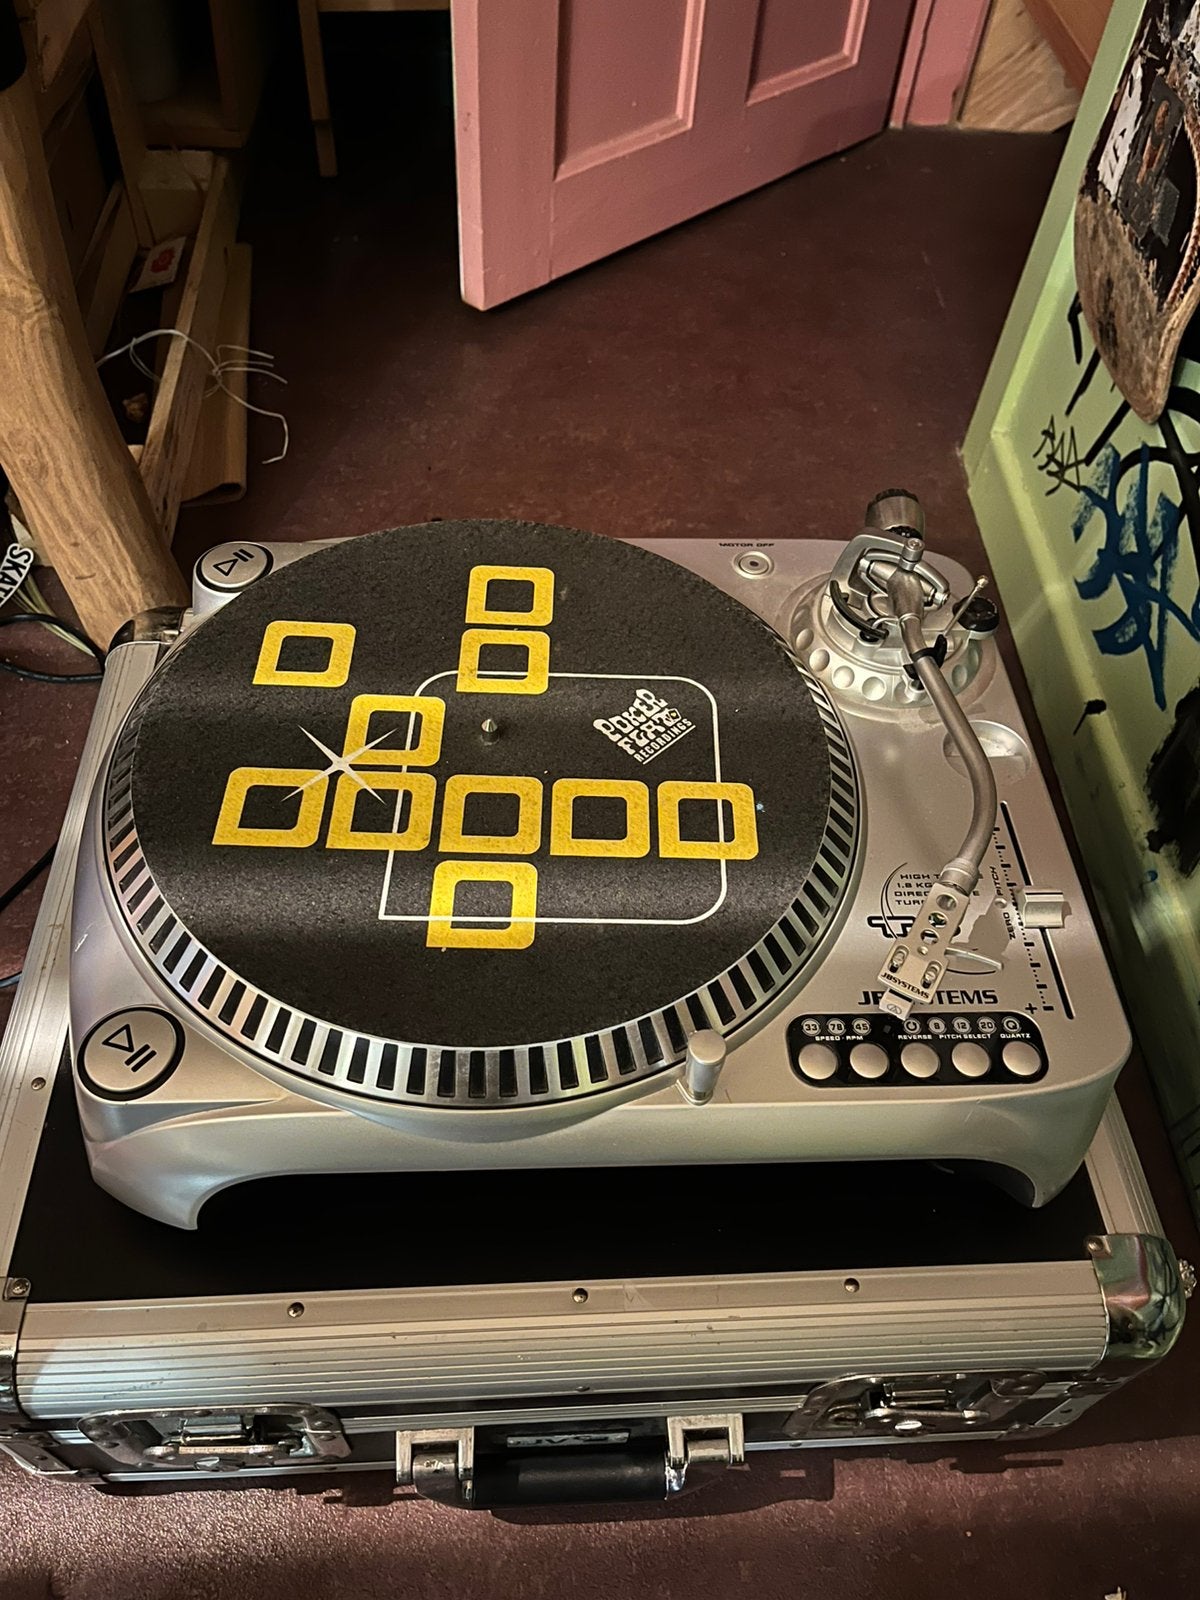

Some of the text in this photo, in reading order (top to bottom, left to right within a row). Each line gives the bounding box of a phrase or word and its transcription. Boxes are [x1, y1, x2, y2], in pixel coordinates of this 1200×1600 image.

[0, 546, 31, 601] SKAT
[593, 688, 668, 742] POKER
[633, 718, 694, 762] RECORDINGS
[989, 866, 1016, 940] ZERO PITCH
[880, 972, 930, 999] JBSYSTEMS
[858, 989, 999, 1005] JBTEMS
[804, 1023, 818, 1031] 33
[829, 1023, 843, 1031] 78
[855, 1023, 868, 1031] 45
[957, 1022, 967, 1030] 12
[980, 1021, 993, 1029] 20
